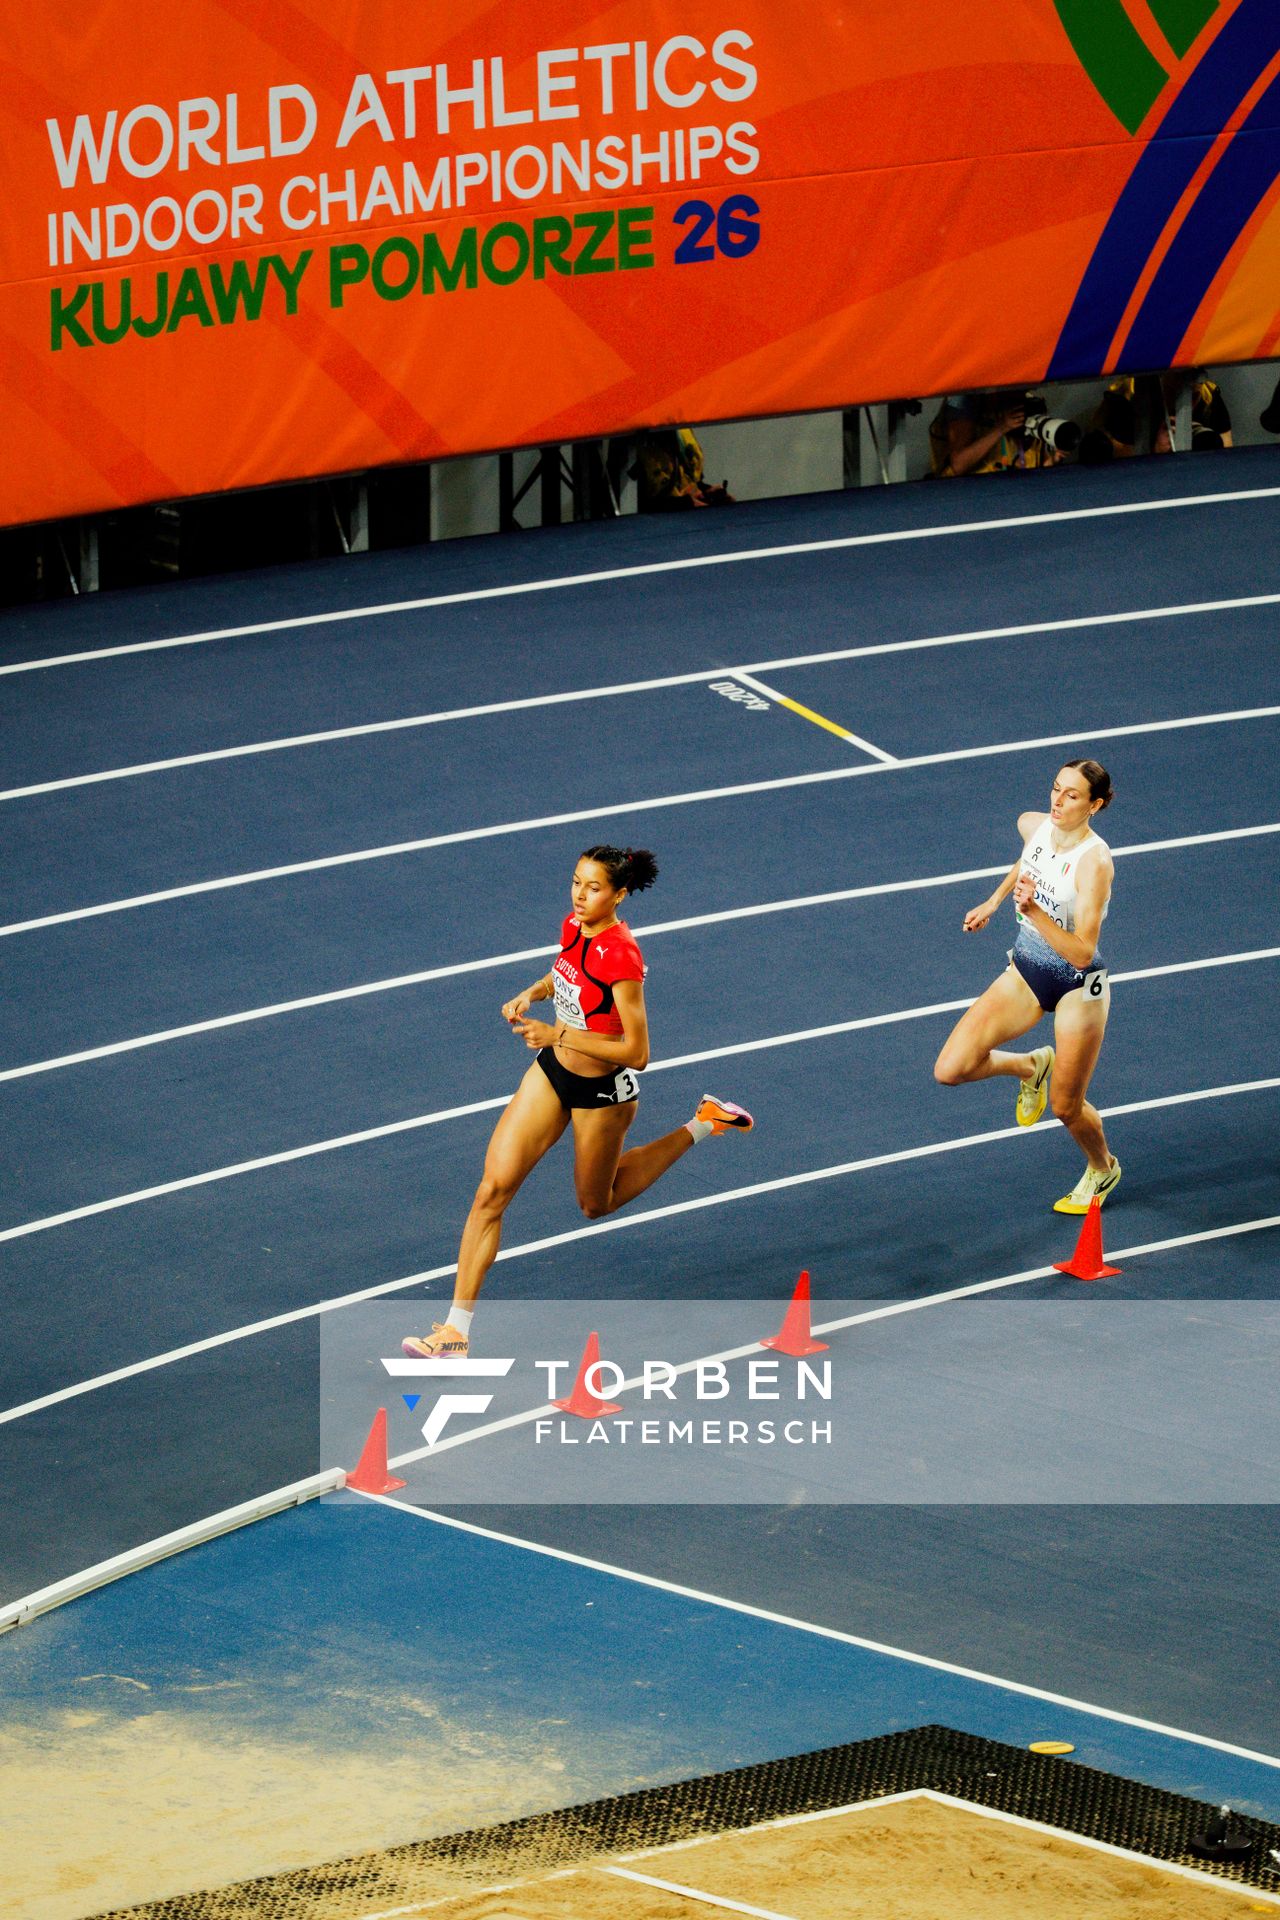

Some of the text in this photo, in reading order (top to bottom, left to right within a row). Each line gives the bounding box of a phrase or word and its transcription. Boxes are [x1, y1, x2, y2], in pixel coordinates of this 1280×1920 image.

[45, 29, 758, 189] WORLD ATHLETICS
[47, 121, 760, 266] INDOOR CHAMPIONSHIPS
[49, 194, 761, 352] KUJAWY POMORZE 26
[556, 957, 579, 984] SUISSE
[1090, 974, 1102, 996] 6
[622, 1074, 634, 1095] 3
